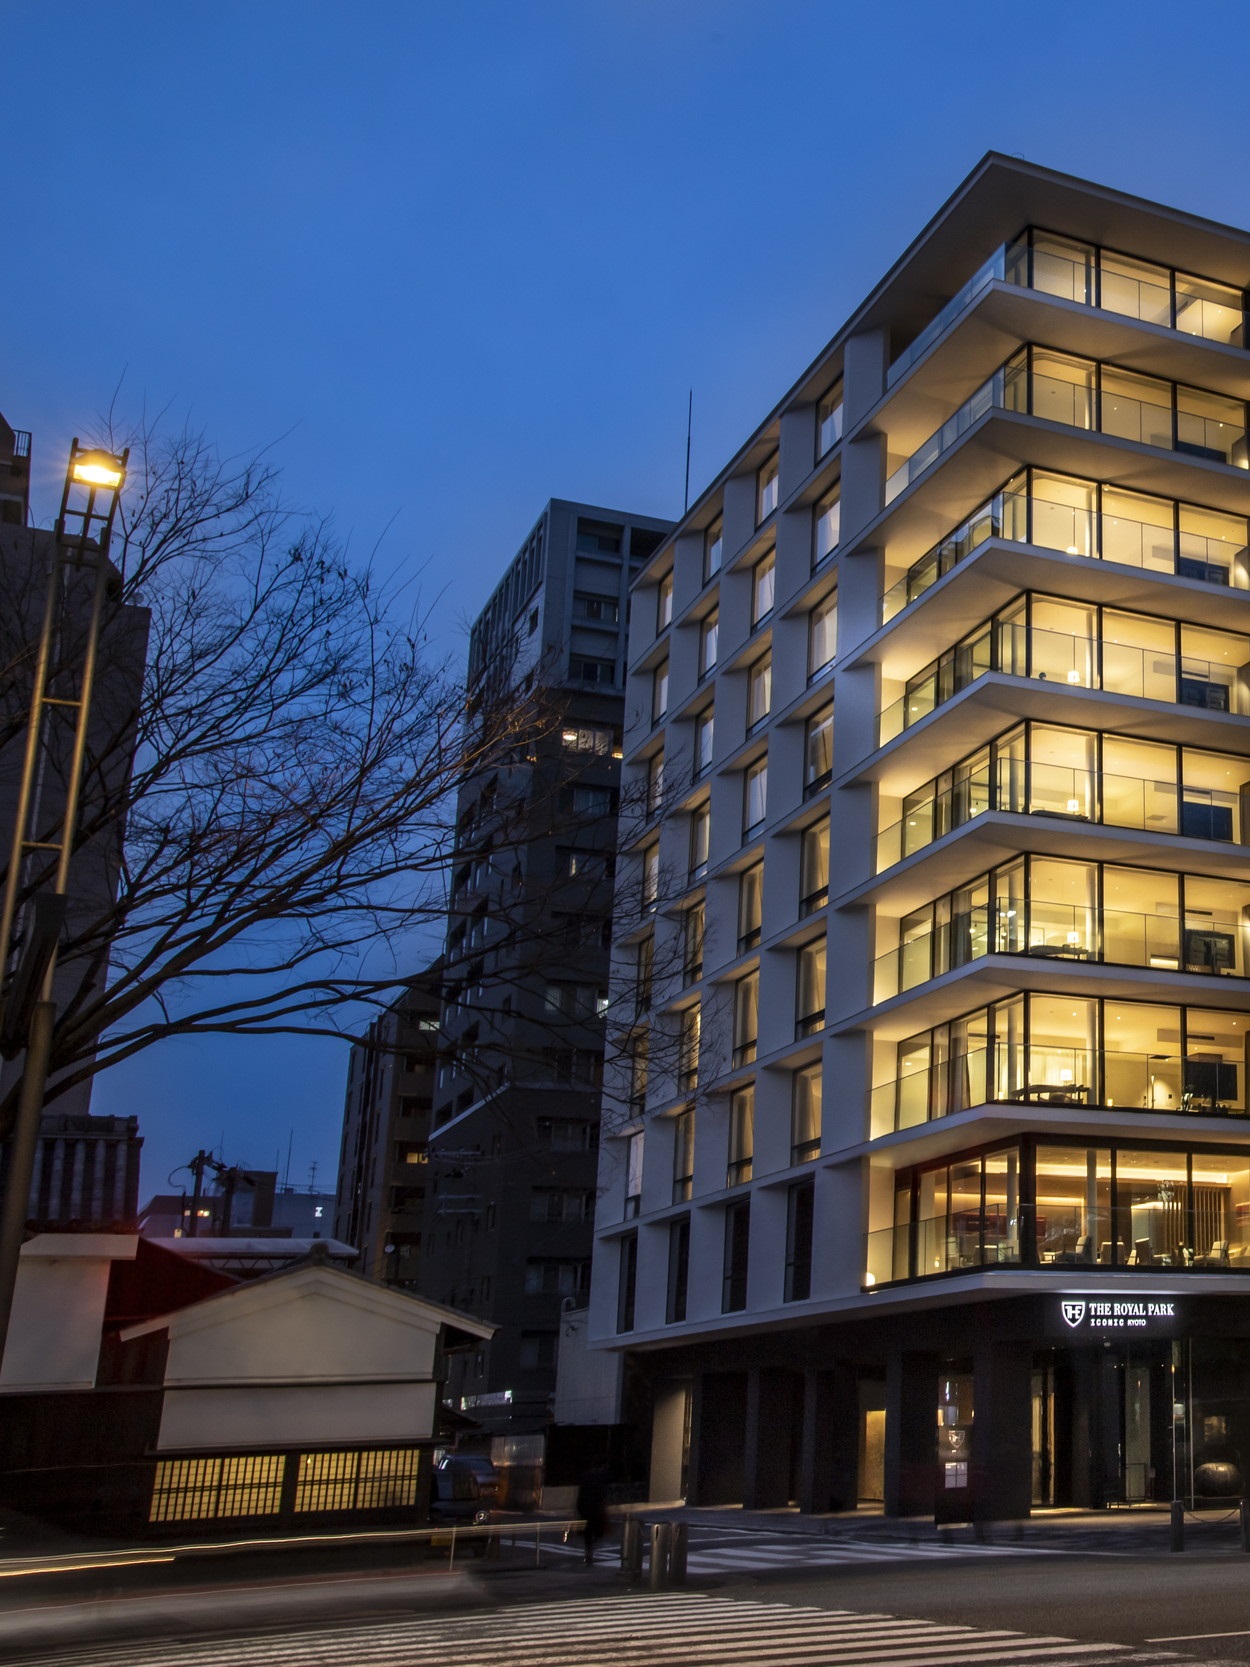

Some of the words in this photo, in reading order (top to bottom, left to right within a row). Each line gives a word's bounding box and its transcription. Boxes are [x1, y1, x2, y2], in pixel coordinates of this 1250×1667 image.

[1089, 1303, 1111, 1316] THE
[1113, 1303, 1146, 1316] ROYAL
[1147, 1303, 1174, 1316] PARK
[1090, 1318, 1124, 1326] ICONIC
